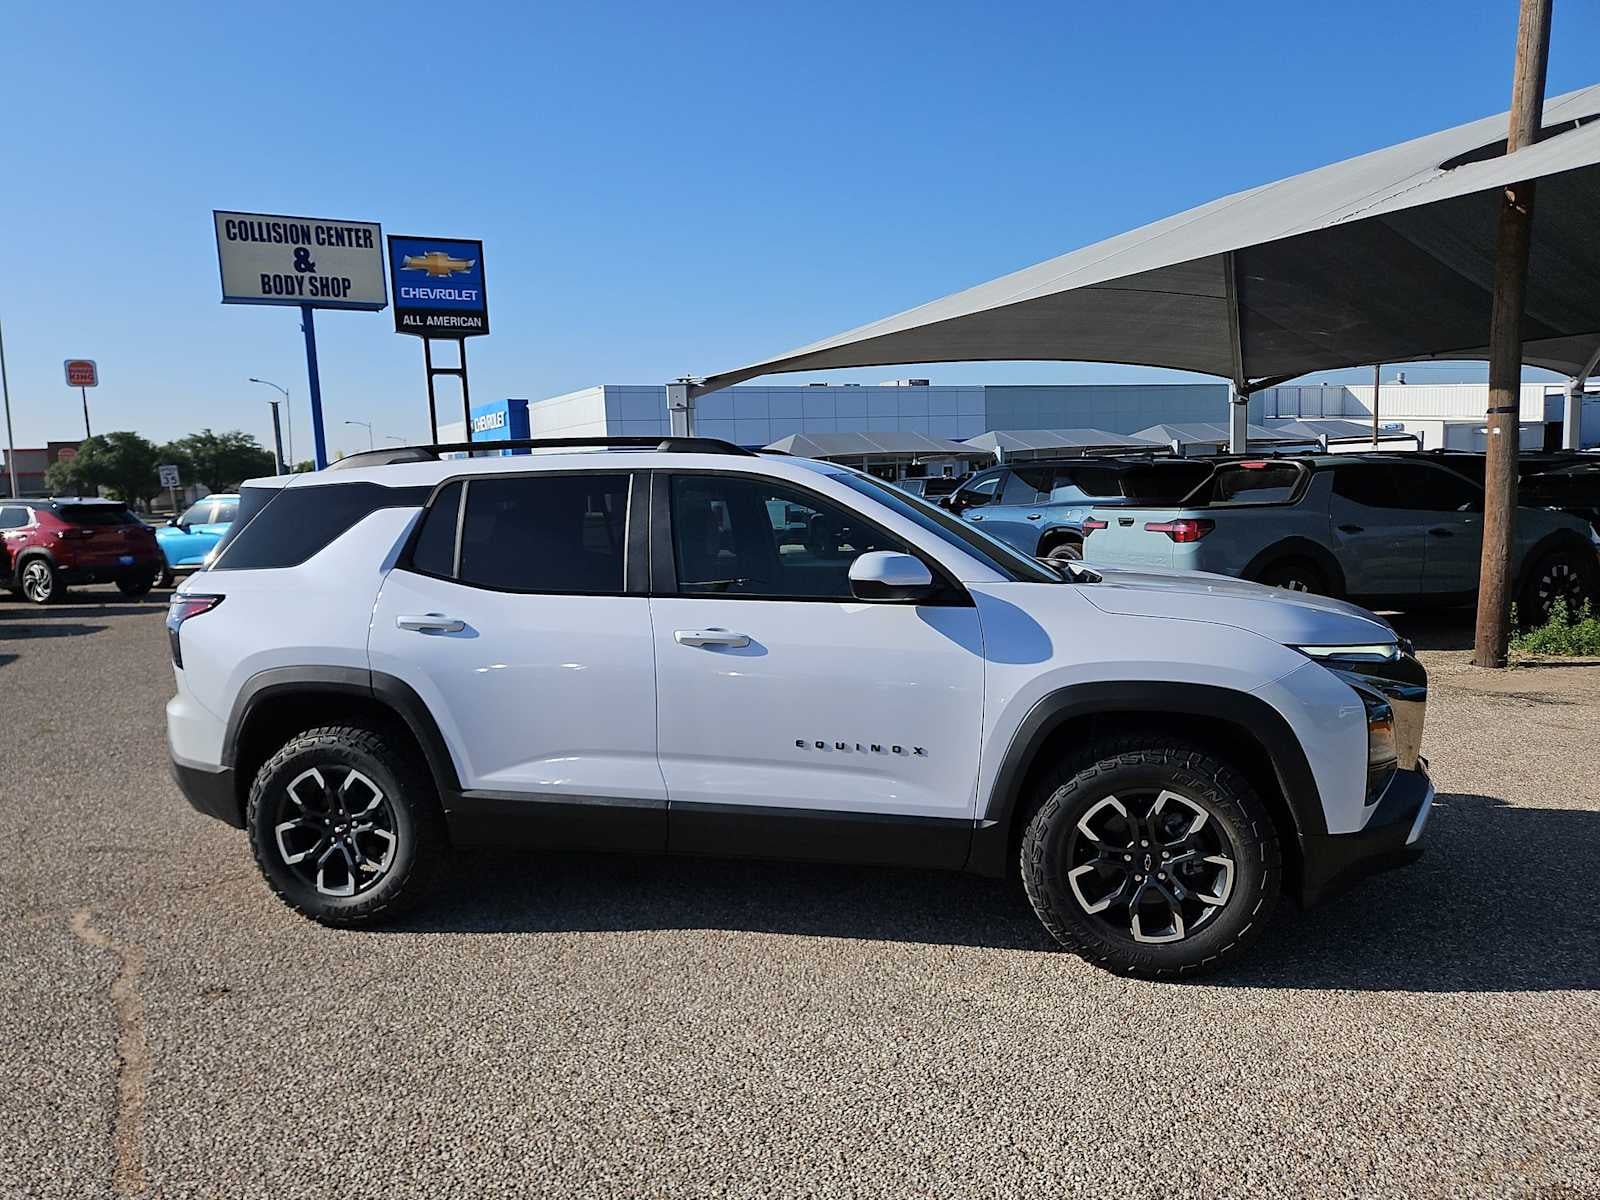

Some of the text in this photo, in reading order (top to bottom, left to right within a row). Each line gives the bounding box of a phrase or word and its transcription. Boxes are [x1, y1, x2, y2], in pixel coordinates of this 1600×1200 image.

[225, 219, 374, 249] COLLISION CENTER
[293, 246, 316, 273] &
[260, 273, 351, 298] BODY SHOP
[400, 287, 478, 301] CHEVROLET
[402, 315, 482, 328] ALL AMERICAN
[163, 475, 177, 485] 35
[795, 739, 924, 756] EQUINOX
